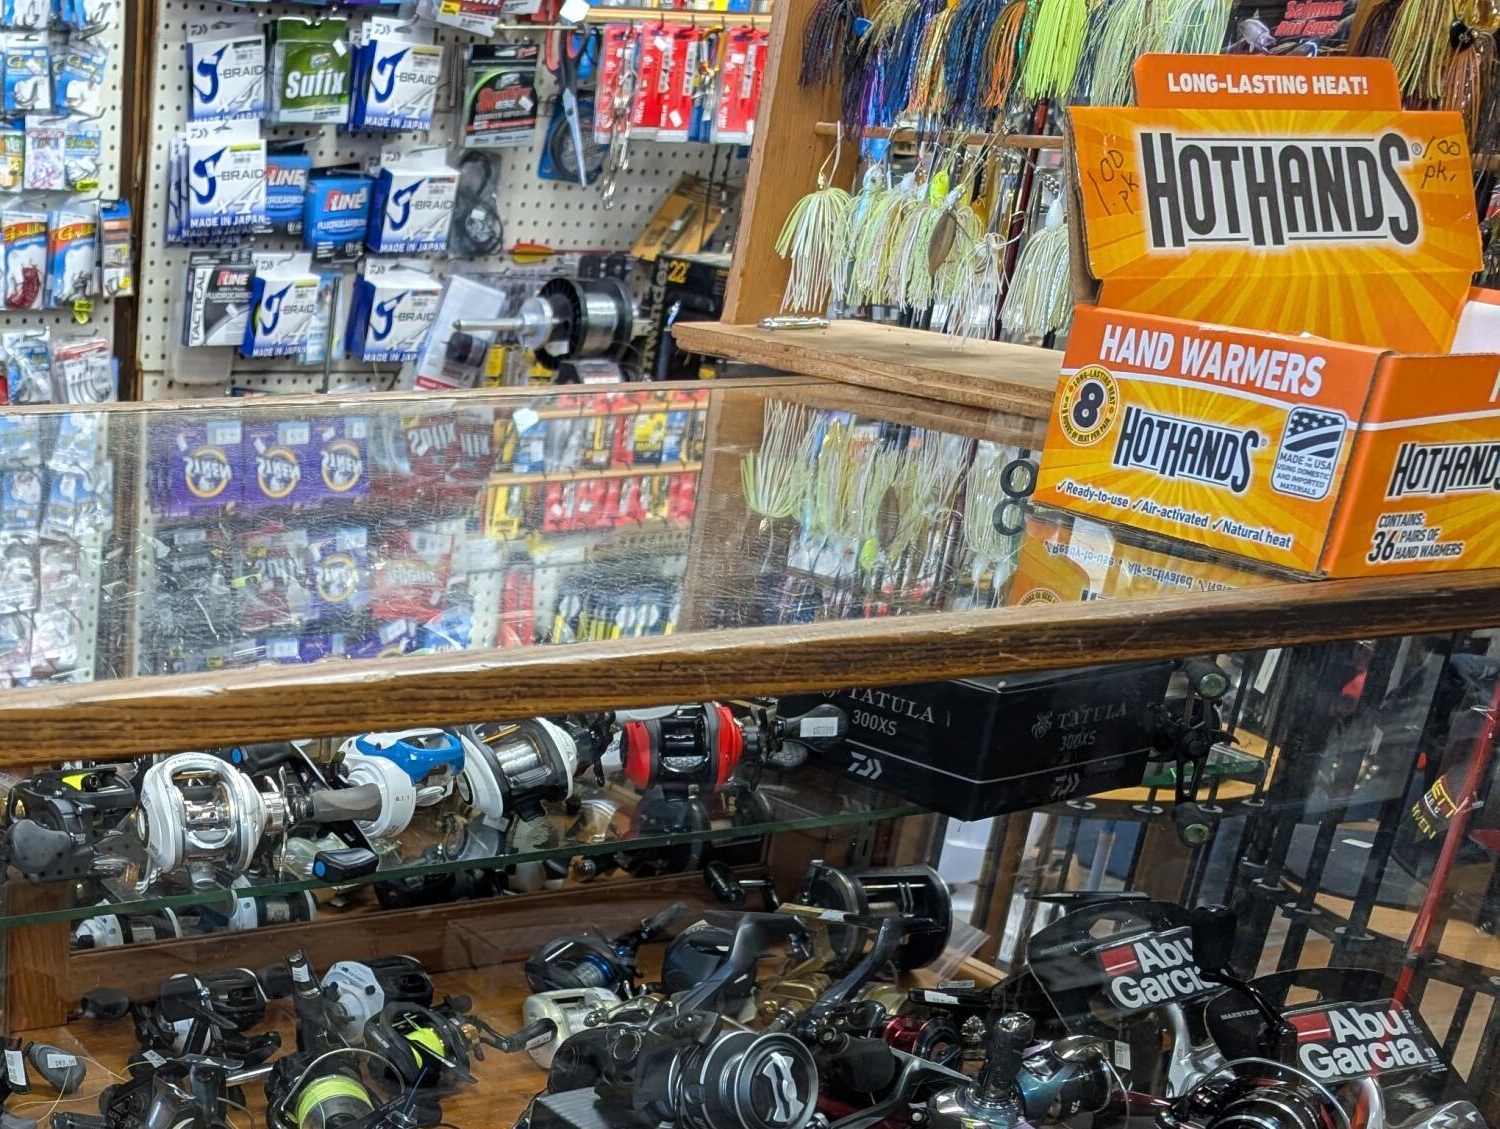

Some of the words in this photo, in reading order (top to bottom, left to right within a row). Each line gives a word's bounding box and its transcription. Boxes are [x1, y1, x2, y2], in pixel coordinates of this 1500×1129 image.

[285, 68, 346, 98] Sufix
[1167, 72, 1309, 94] LONG-LASTING
[1312, 75, 1369, 96] HEAT!
[190, 215, 220, 226] MADE
[221, 214, 231, 225] IN
[232, 213, 265, 224] JAPAN
[1100, 324, 1174, 371] HAND
[1180, 336, 1327, 398] WARMERS
[1072, 382, 1104, 428] 8
[1276, 463, 1297, 473] USING
[1297, 468, 1330, 481] DOMESTIC
[1280, 452, 1305, 465] MADE
[1314, 459, 1332, 471] USA
[1276, 473, 1291, 481] AND
[1291, 475, 1325, 488] IMPORTED
[1280, 482, 1317, 496] MATERIALS
[1065, 481, 1129, 508] Ready-to-use
[1142, 500, 1209, 529] Air-activated
[1222, 521, 1265, 541] Natural
[1265, 531, 1292, 548] heat
[1378, 513, 1424, 528] CONTAINS:
[1368, 530, 1399, 562] 36
[1400, 529, 1427, 541] PAIRS
[1428, 528, 1440, 540] OF
[1395, 545, 1420, 560] HAND
[1420, 542, 1463, 558] WARMERS
[852, 709, 899, 737] 300XS
[1327, 1008, 1409, 1043] Abu
[1298, 1037, 1425, 1079] Garcia
